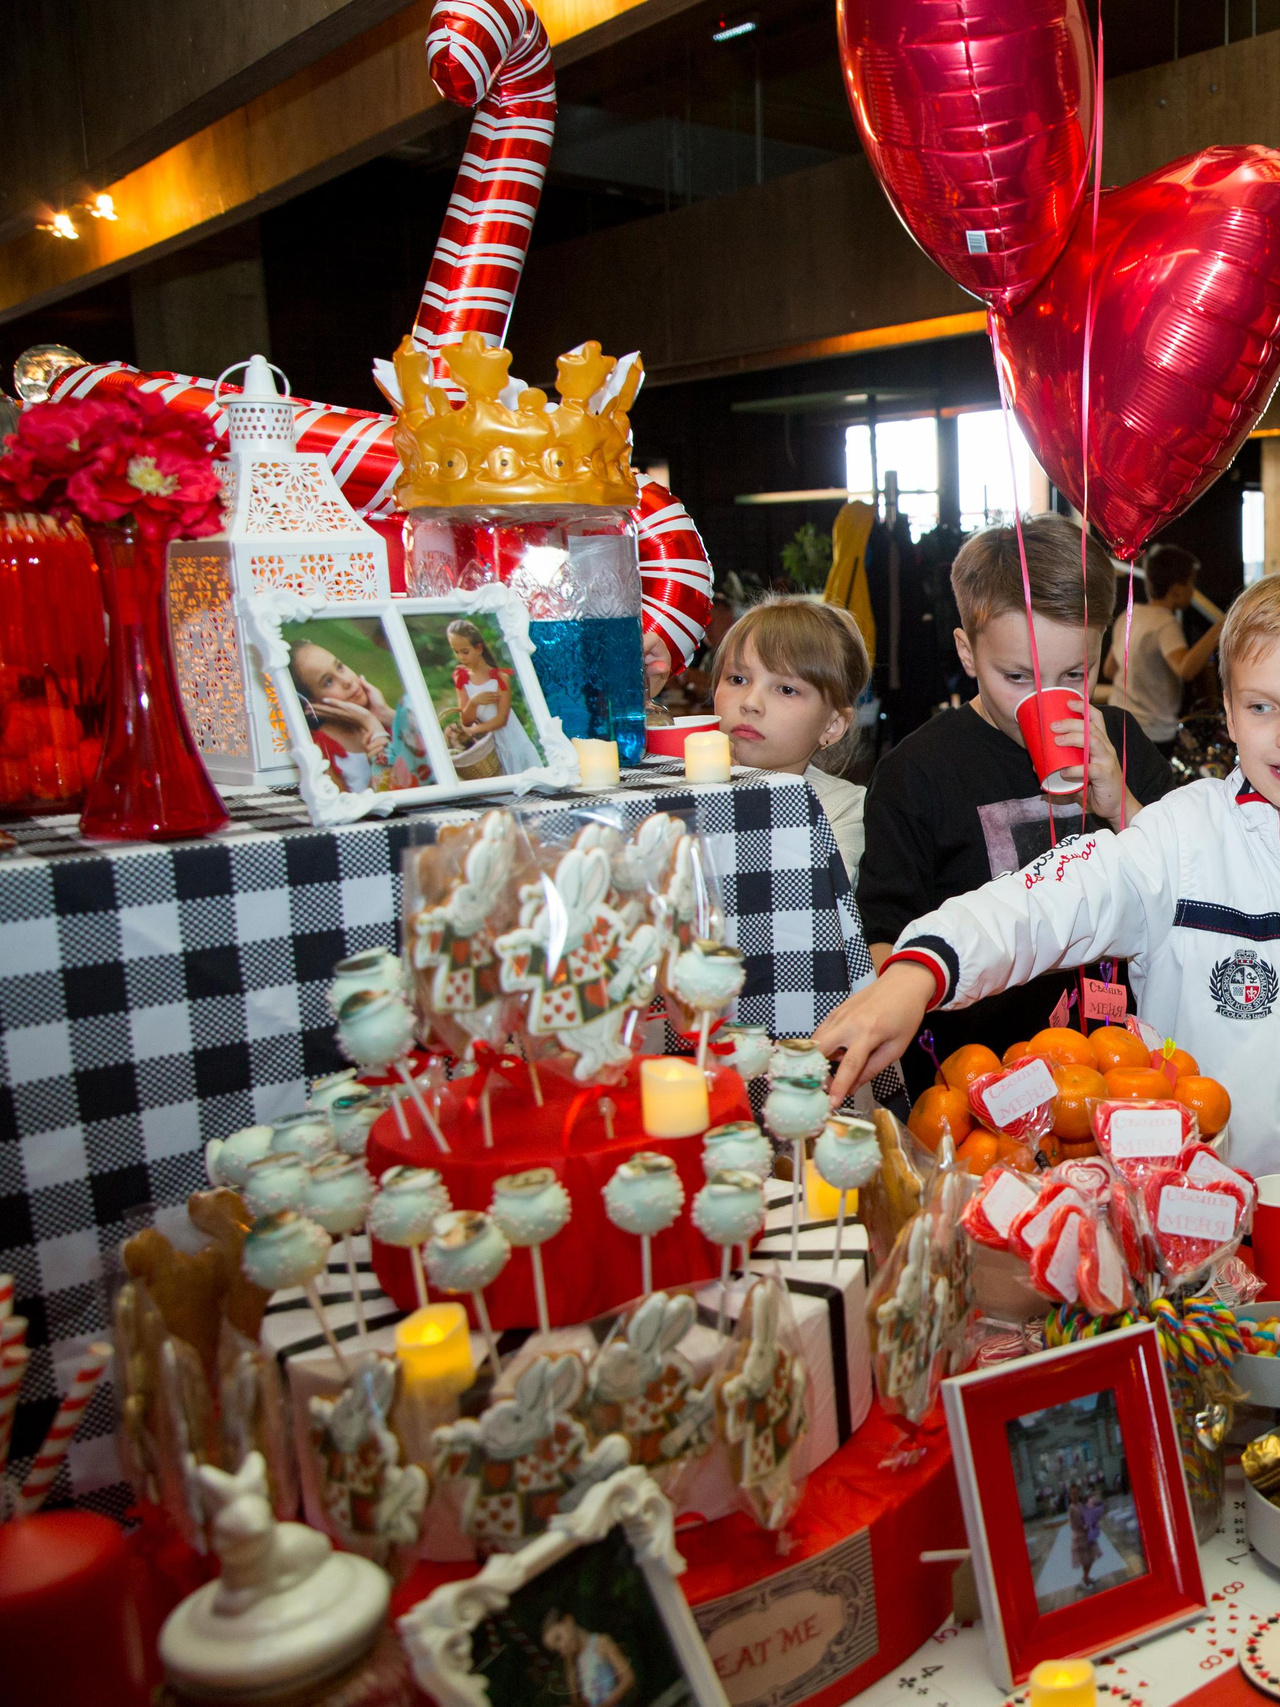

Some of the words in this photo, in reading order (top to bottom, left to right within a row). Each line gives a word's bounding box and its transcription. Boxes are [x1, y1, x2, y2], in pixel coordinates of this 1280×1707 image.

[1223, 1581, 1245, 1594] 8
[712, 1638, 771, 1681] EAT
[776, 1613, 822, 1654] ME
[1199, 1655, 1222, 1670] 8
